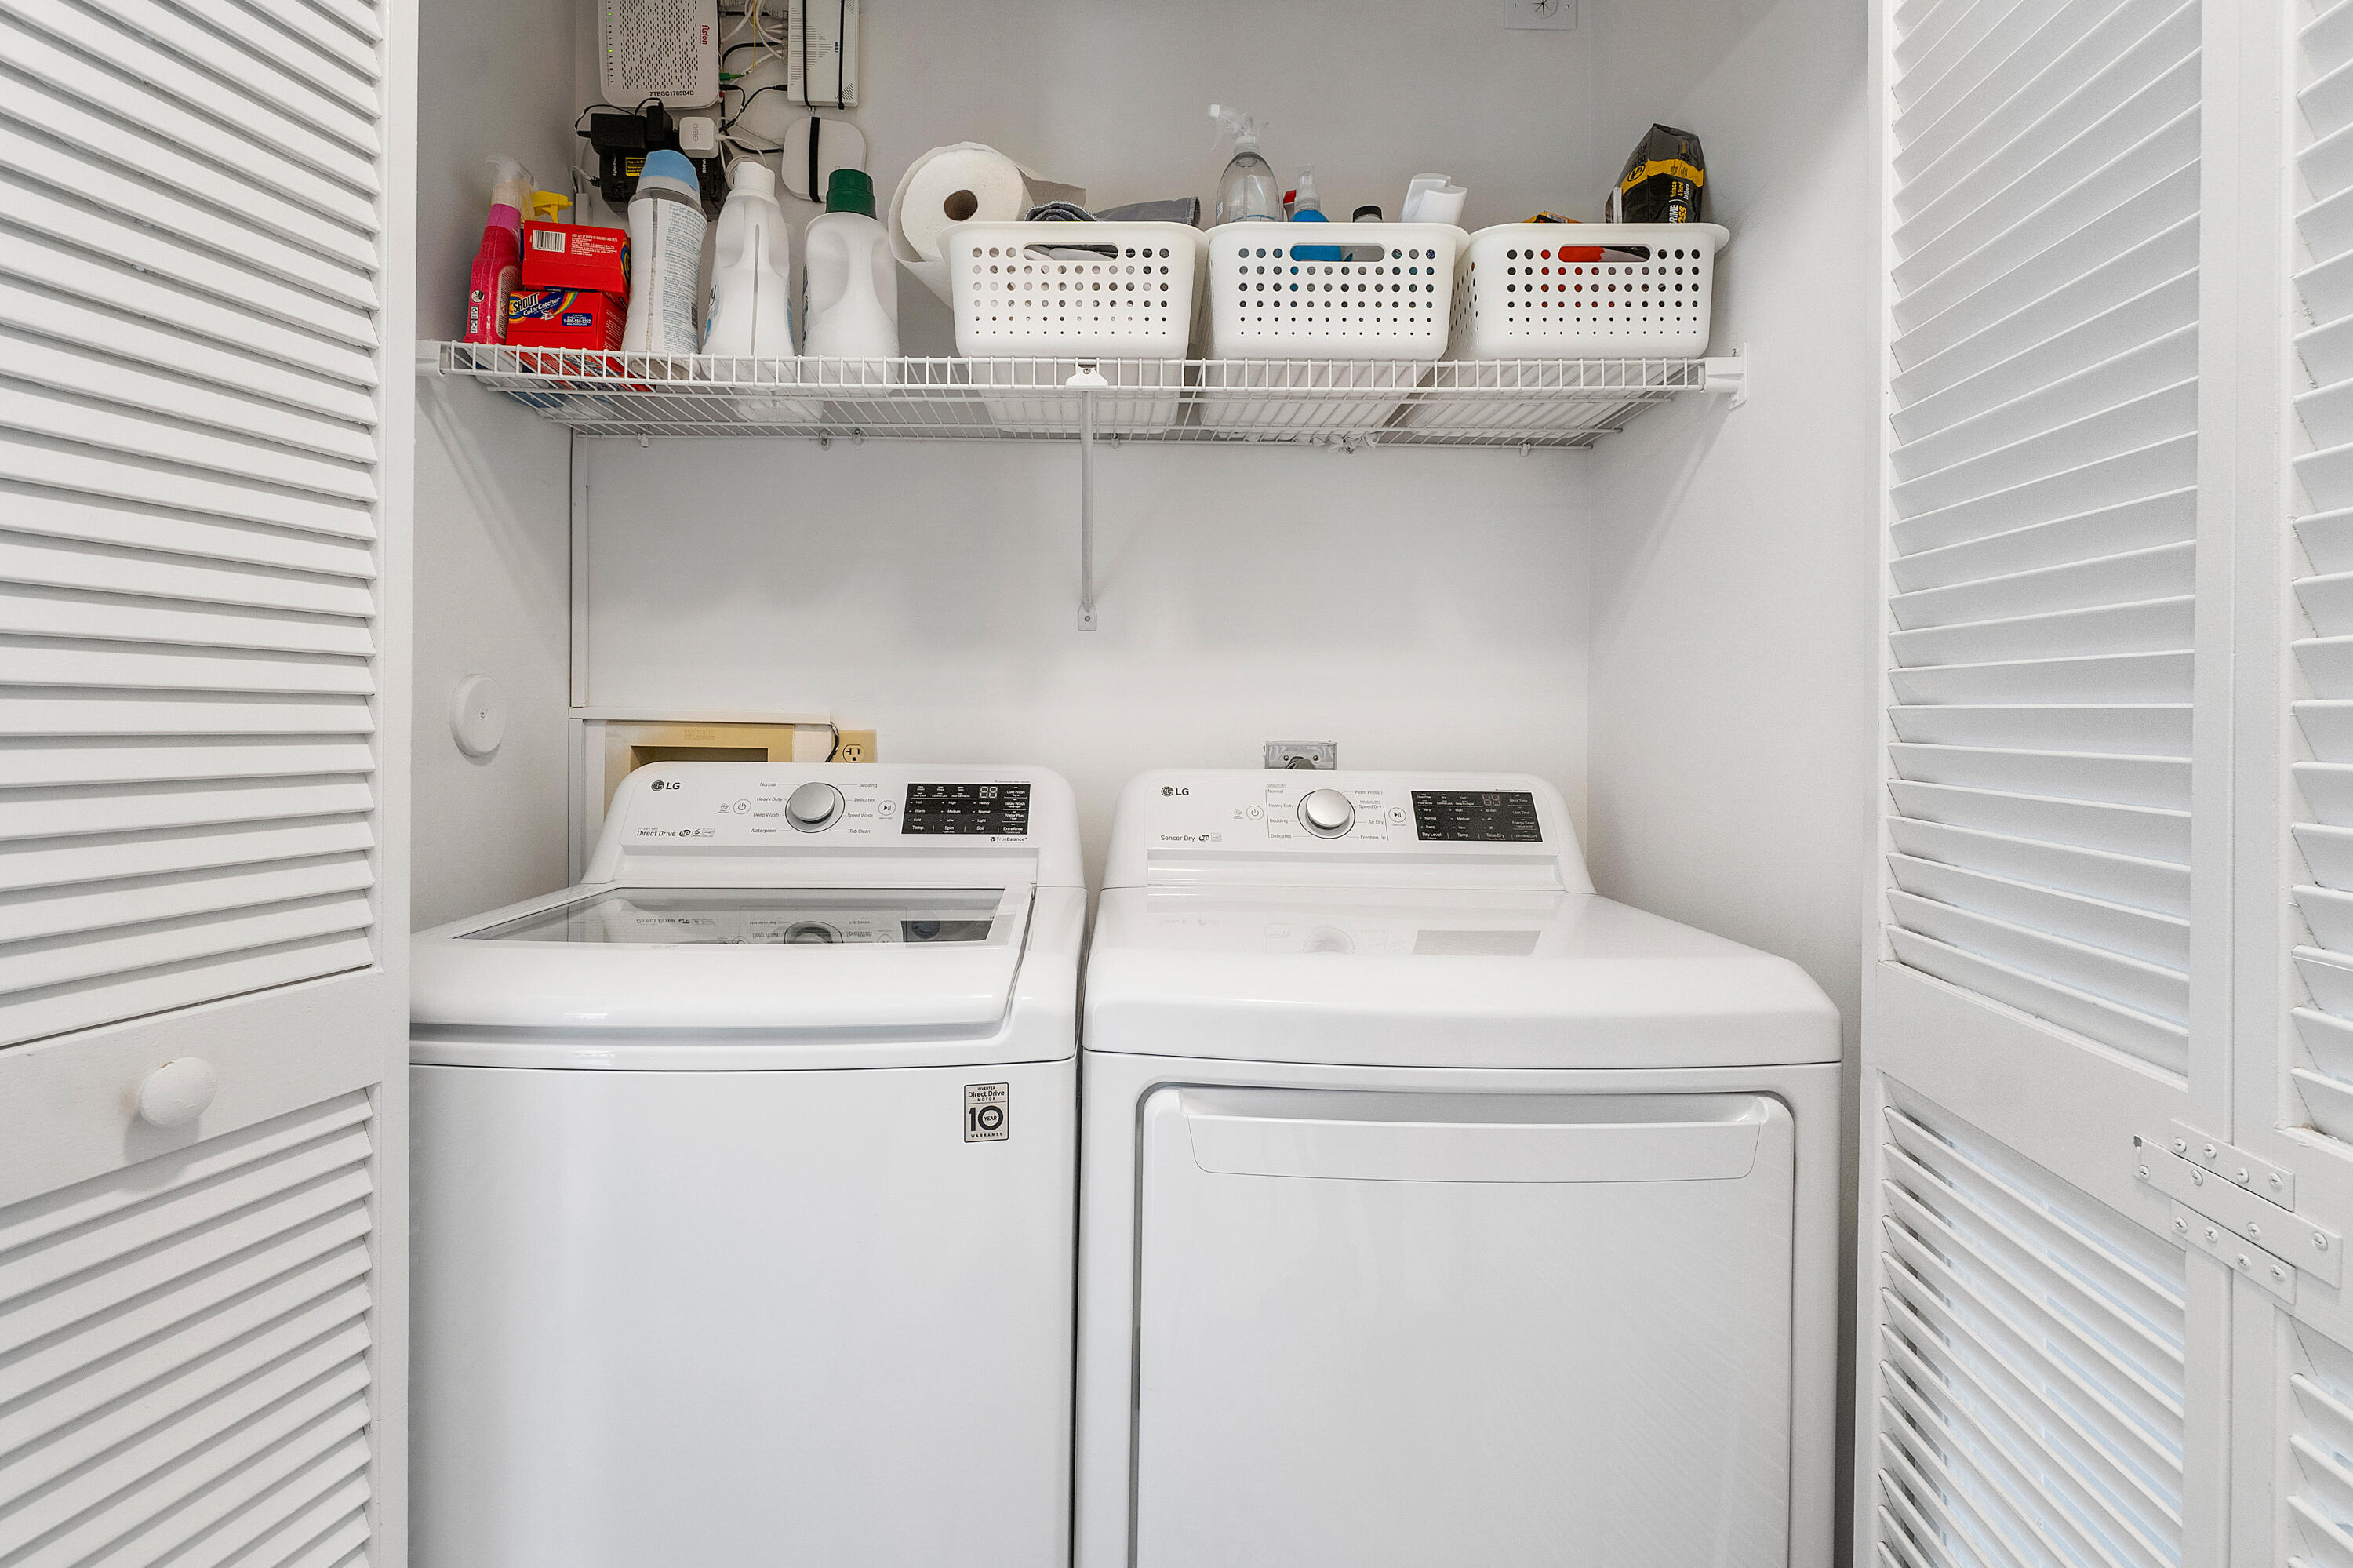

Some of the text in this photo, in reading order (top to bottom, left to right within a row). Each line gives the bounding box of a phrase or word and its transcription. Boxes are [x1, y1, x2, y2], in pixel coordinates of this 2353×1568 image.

[1669, 204, 1679, 224] RIME
[512, 292, 540, 314] SHOUT
[523, 297, 561, 316] ColorCatcher
[969, 1105, 1004, 1132] 10
